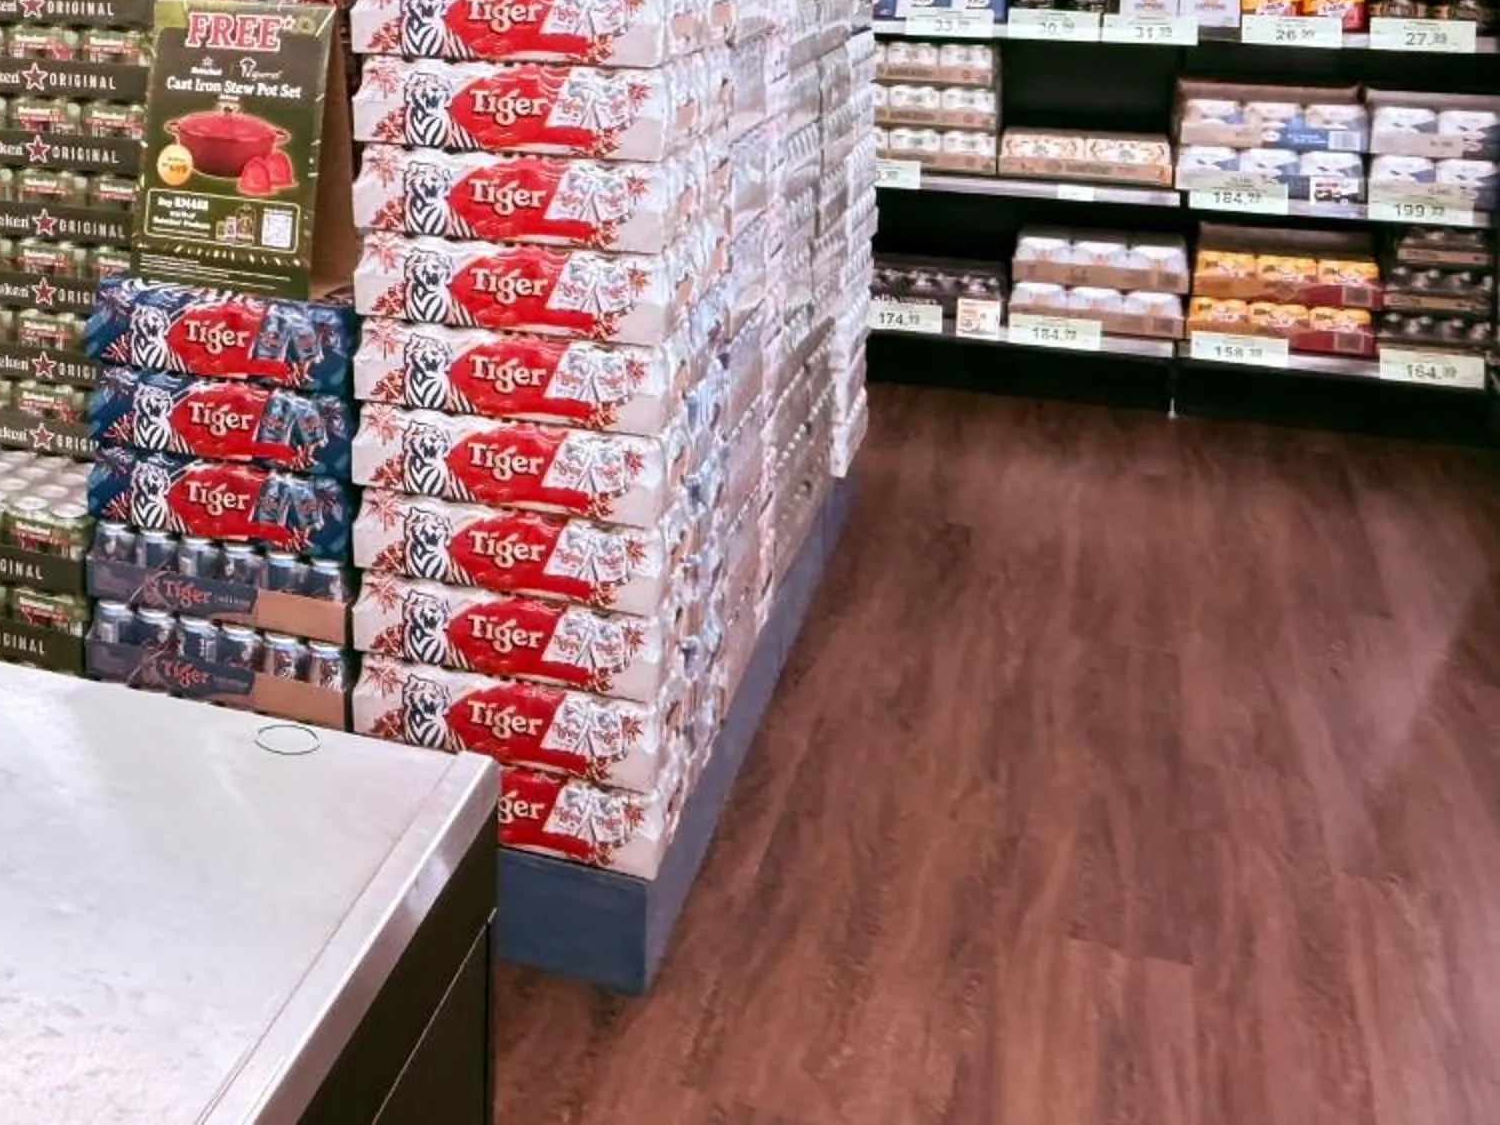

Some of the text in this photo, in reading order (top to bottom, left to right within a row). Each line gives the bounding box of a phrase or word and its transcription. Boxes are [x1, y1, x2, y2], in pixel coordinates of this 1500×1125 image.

[47, 2, 115, 16] ORIGINAL
[185, 11, 281, 52] FREE
[49, 72, 117, 90] ORIGINAL
[166, 75, 302, 100] Cast Iron Stew Pot Set
[470, 88, 549, 126] Tiger
[52, 146, 120, 163] ORIGINAL
[470, 178, 547, 216] Tiger
[59, 219, 125, 239] ORIGINAL
[58, 289, 97, 305] ORIGI
[470, 268, 548, 305] Tiger
[184, 319, 250, 355] Tiger
[58, 363, 97, 380] ORIGI
[470, 355, 547, 393] Tiger
[188, 401, 254, 437] Tiger
[56, 435, 100, 452] ORIGI
[468, 442, 545, 481] Tiger
[185, 481, 251, 516] Tiger
[468, 530, 546, 568] Tiger
[163, 580, 212, 608] Tiger
[467, 614, 544, 652] Tiger
[162, 660, 209, 688] Tiger
[467, 700, 543, 739] Tiger
[499, 790, 545, 824] ger
